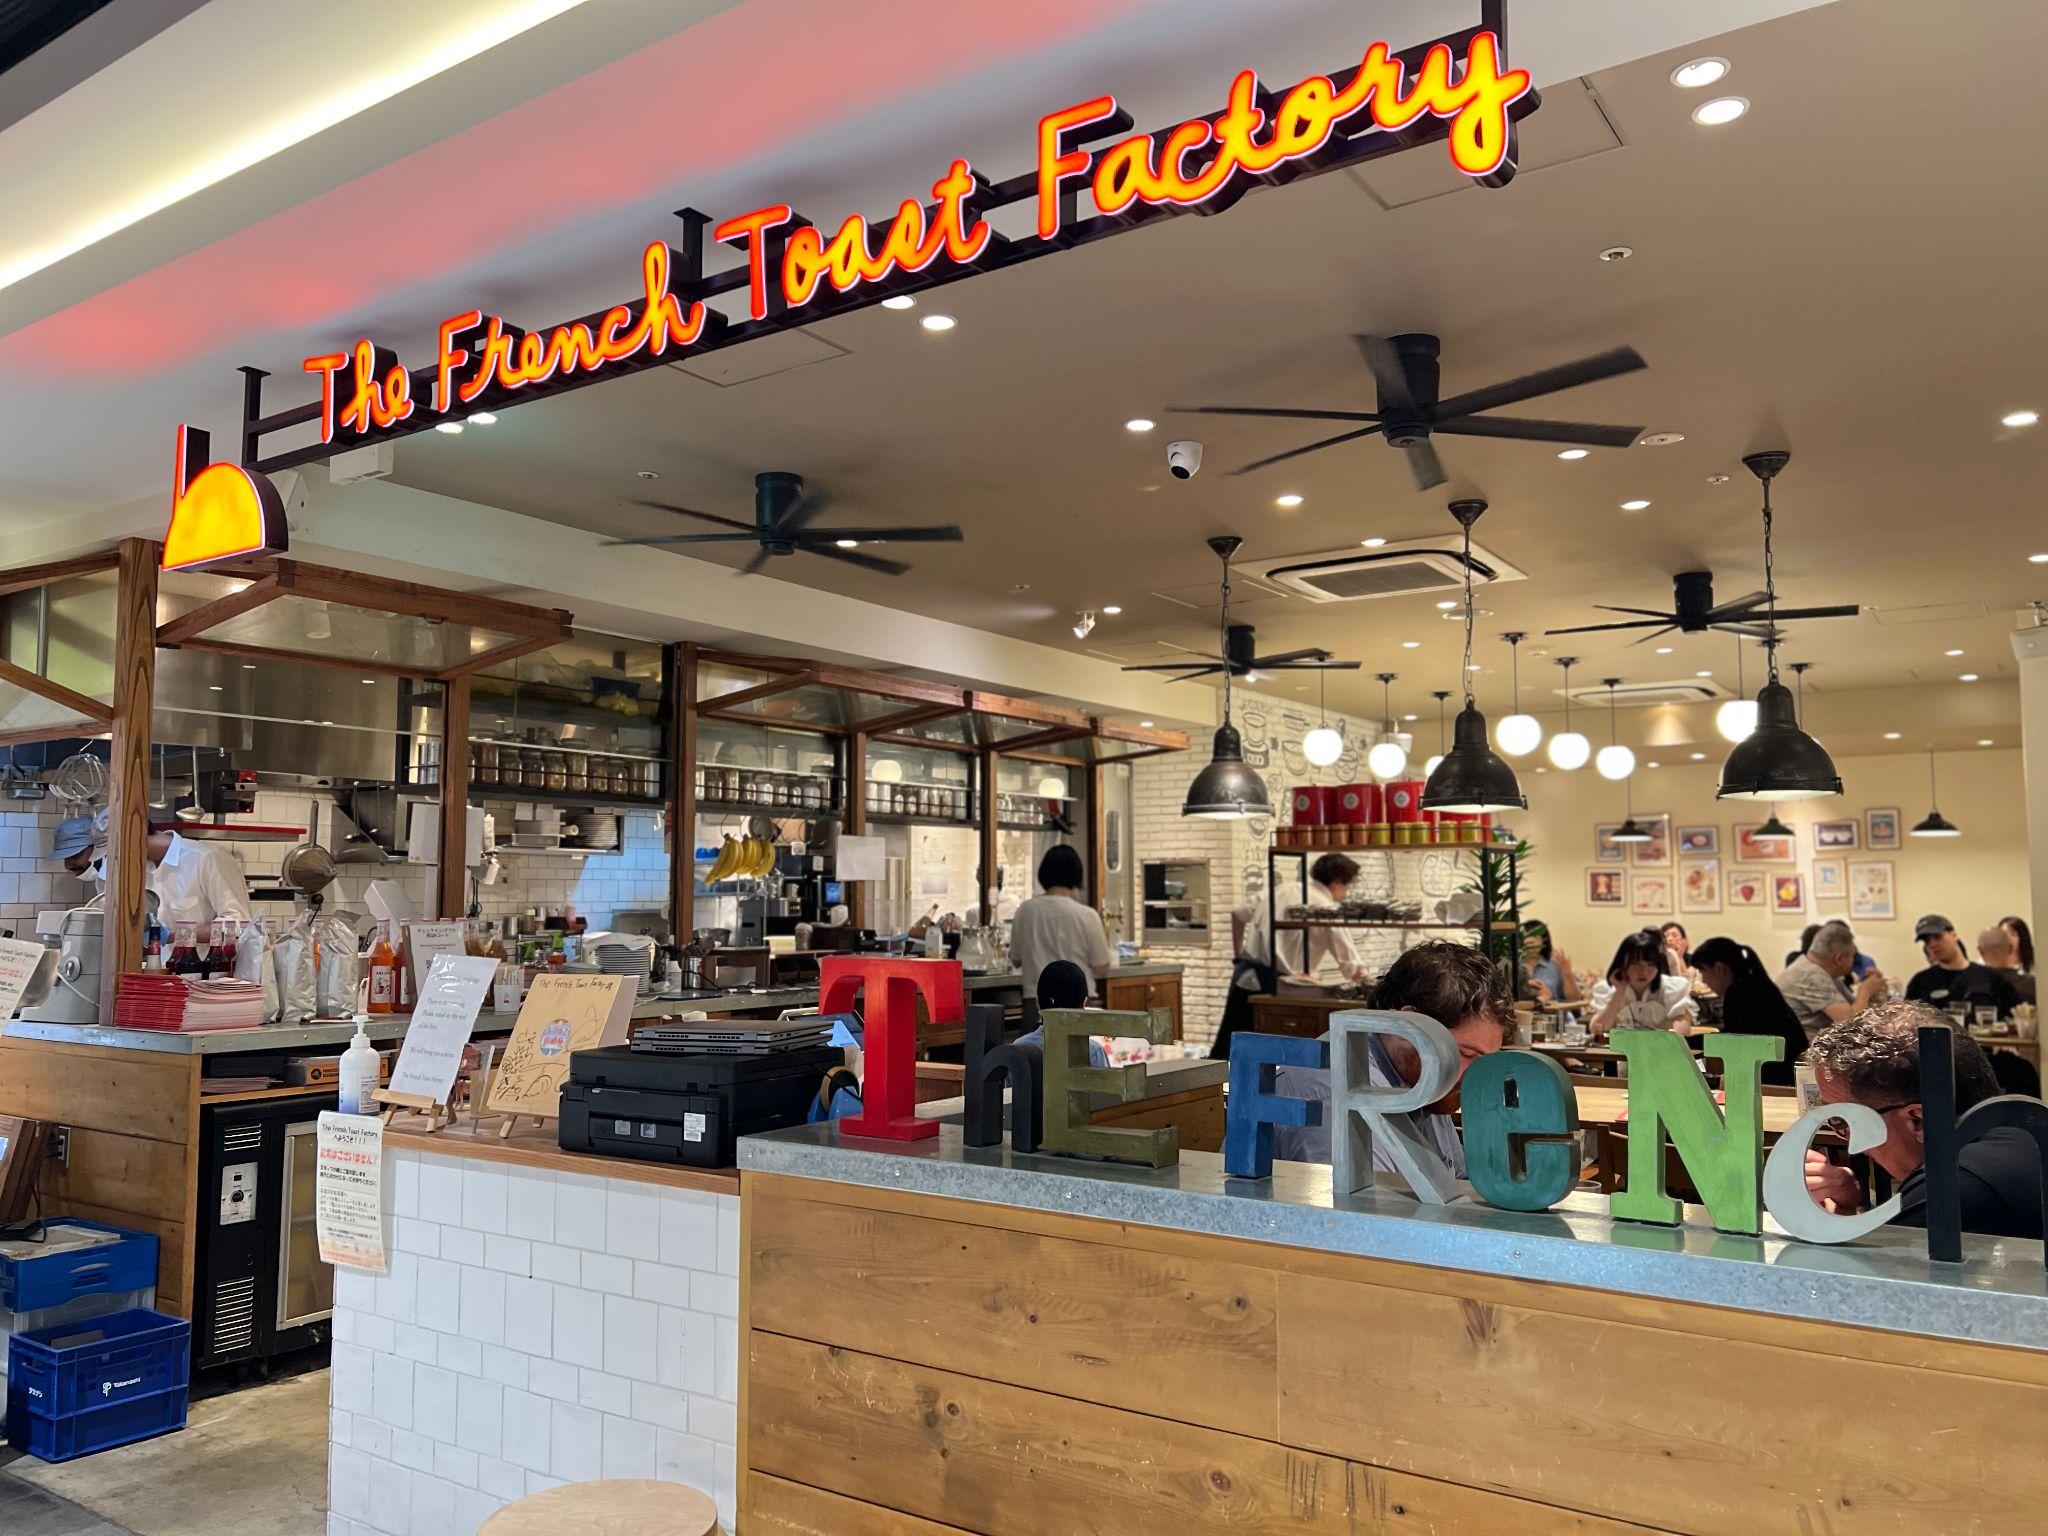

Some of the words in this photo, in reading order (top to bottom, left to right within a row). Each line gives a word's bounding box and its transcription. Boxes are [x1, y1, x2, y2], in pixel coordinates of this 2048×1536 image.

[303, 339, 414, 445] The
[437, 240, 707, 414] French
[714, 157, 992, 321] Toast
[1037, 29, 1532, 250] Factory
[332, 1124, 347, 1133] French
